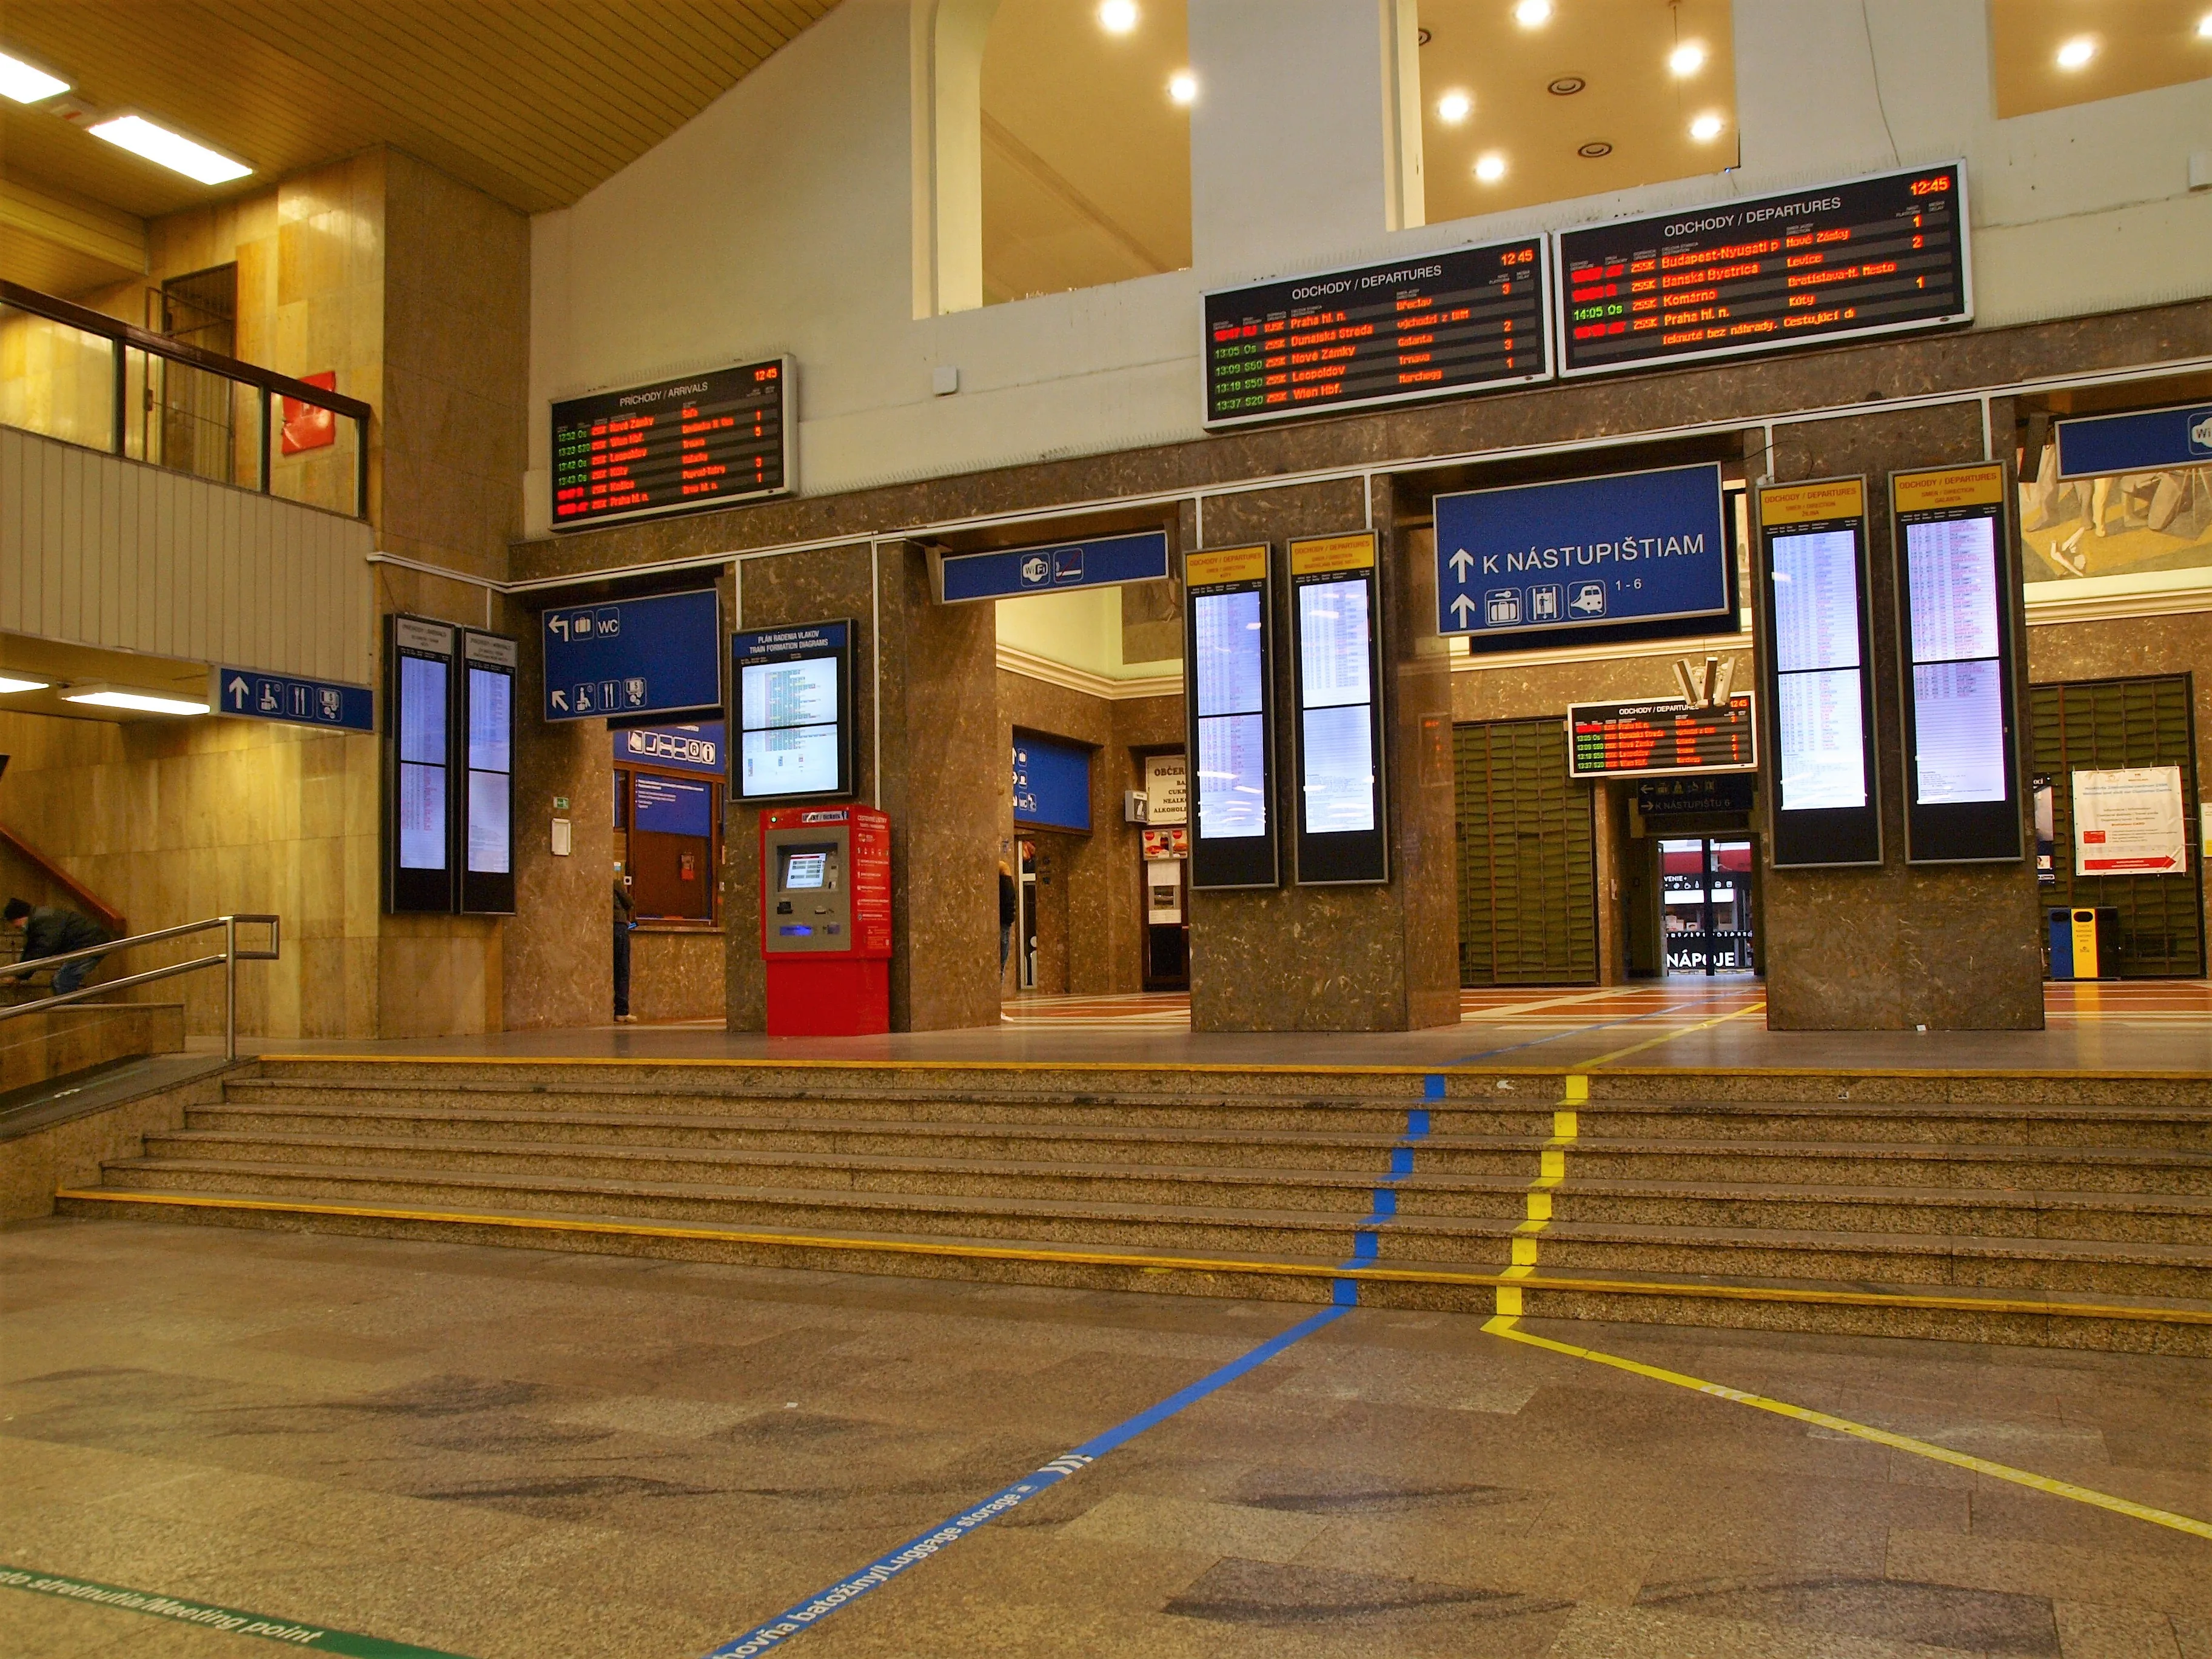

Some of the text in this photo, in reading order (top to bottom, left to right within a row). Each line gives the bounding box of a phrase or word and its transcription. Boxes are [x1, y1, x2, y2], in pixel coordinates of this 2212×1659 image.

[1911, 177, 1949, 195] 12:45
[1664, 215, 1734, 236] ODCHODY
[1746, 196, 1841, 223] DEPARTURES
[1912, 215, 1922, 227] 1
[1708, 263, 1759, 280] Bystrica
[1788, 253, 1823, 267] Levice
[1912, 235, 1923, 249] 2
[1292, 281, 1352, 300] ODCHODY
[1362, 266, 1441, 288] DEPARTURES
[1574, 306, 1603, 320] 14:05
[1608, 305, 1623, 315] Os
[1664, 289, 1717, 306] Komárno
[1863, 262, 1896, 276] Mesto
[1291, 315, 1319, 329] Praha
[1502, 283, 1511, 295] 3
[1664, 310, 1697, 326] Praha
[1916, 276, 1925, 288] 1
[1504, 320, 1513, 332] 2
[1707, 328, 1725, 338] bez
[1215, 346, 1239, 359] 13:05
[1504, 338, 1513, 350] 3
[1293, 386, 1318, 400] Wien
[1506, 357, 1513, 369] 1
[668, 381, 708, 398] ARRIVALS
[1899, 479, 1937, 489] ODCHODY
[1945, 473, 1997, 484] DEPARTURES
[1765, 494, 1800, 503] ODCHODY
[1808, 488, 1856, 499] DEPARTURES
[1483, 534, 1704, 574] K NÁSTUPIŠTIAM
[1615, 580, 1621, 591] 1
[1634, 578, 1642, 589] 6
[598, 619, 618, 634] WC
[957, 1493, 1021, 1527] storage
[238, 1621, 324, 1643] point
